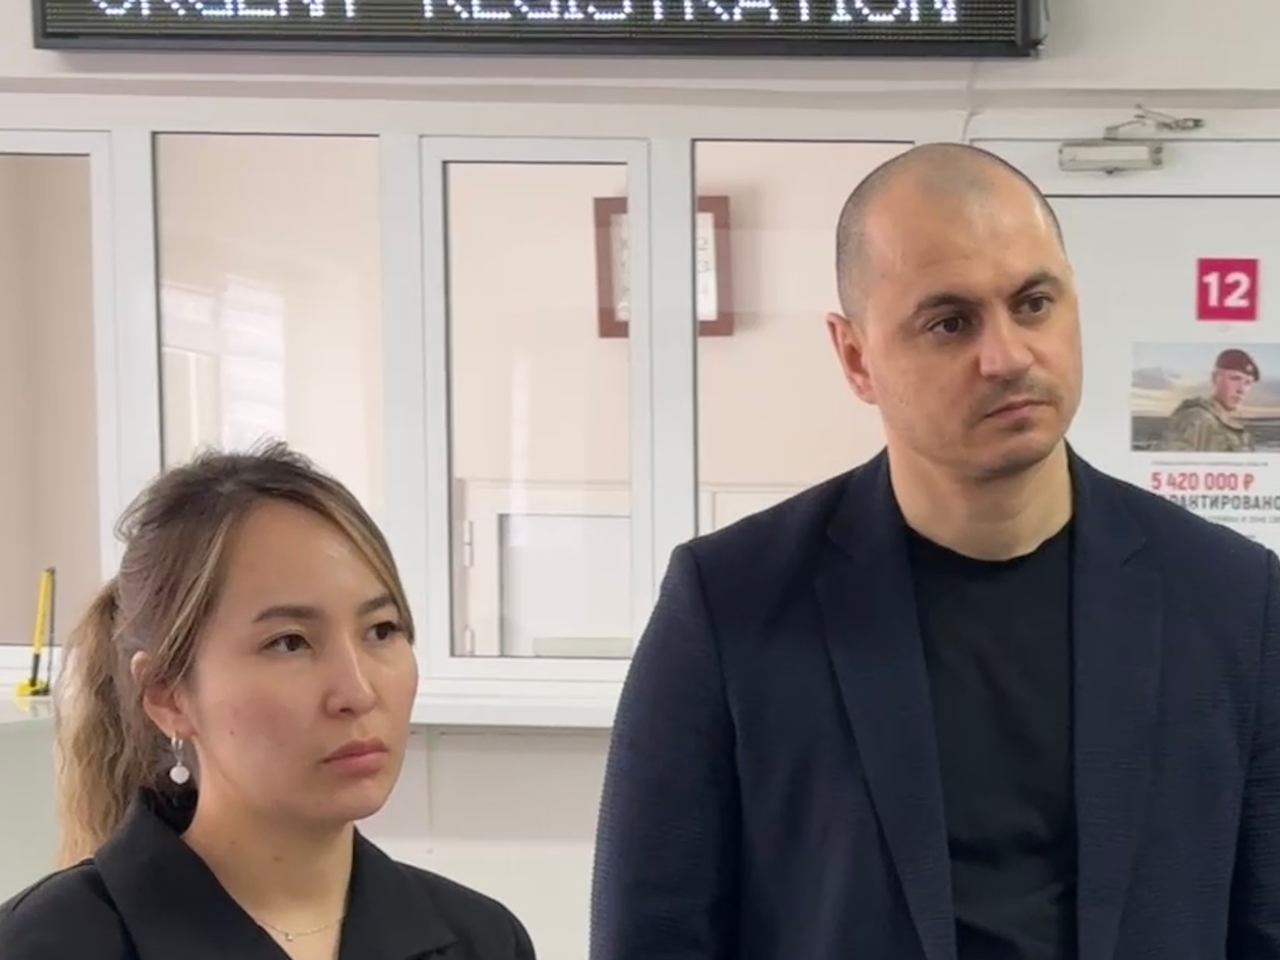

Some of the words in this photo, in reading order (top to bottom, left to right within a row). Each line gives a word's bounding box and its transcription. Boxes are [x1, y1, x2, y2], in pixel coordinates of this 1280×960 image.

[1202, 271, 1251, 308] 12
[1151, 472, 1162, 490] 5
[1166, 473, 1198, 490] 420
[1204, 473, 1238, 491] 000
